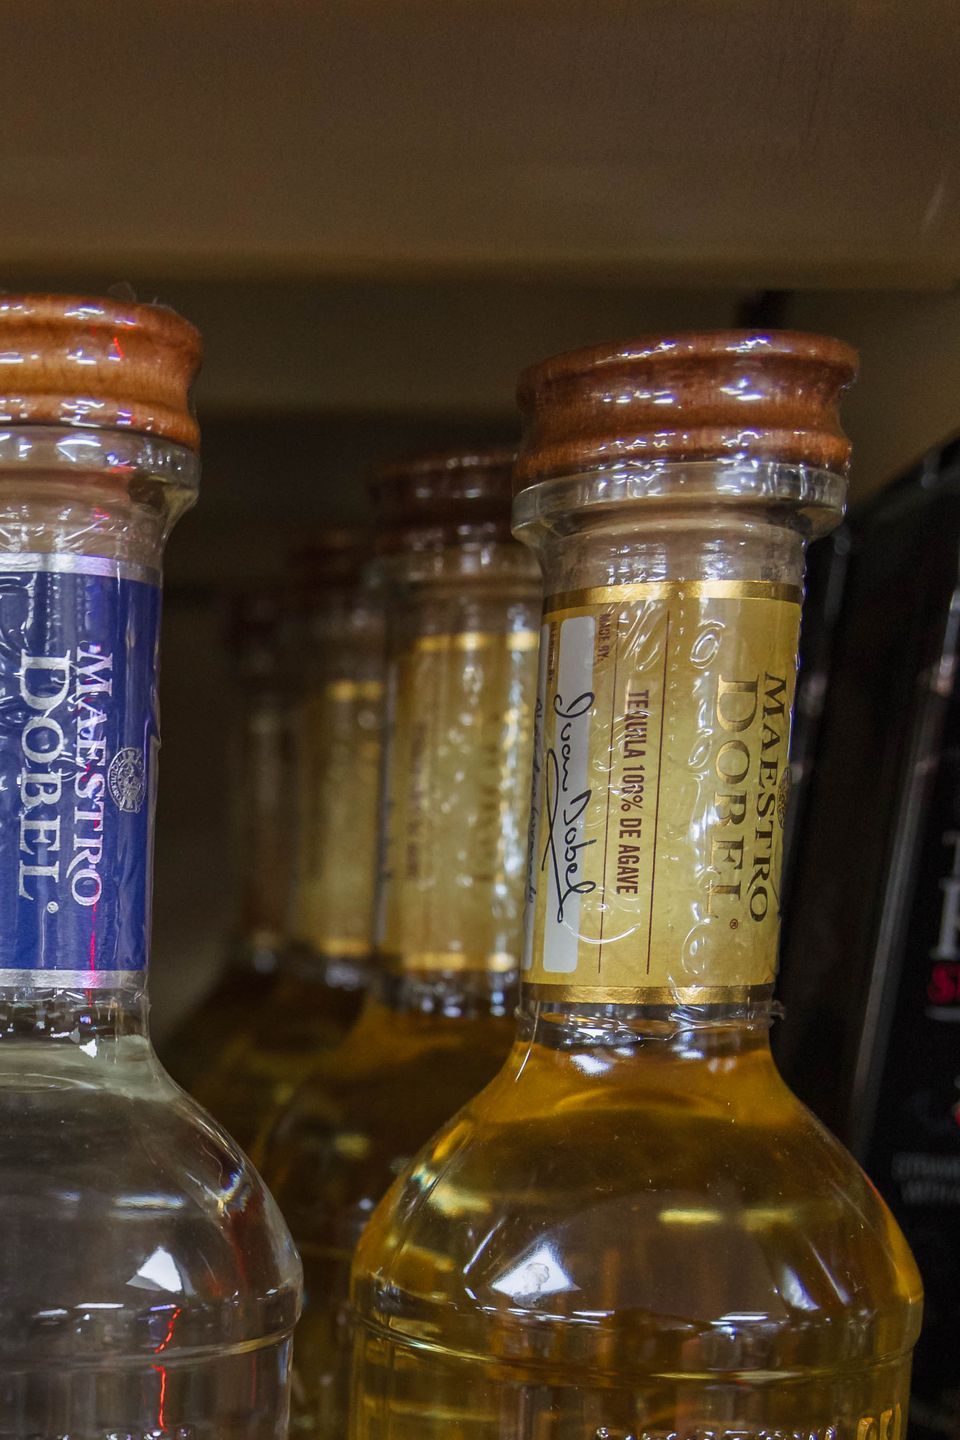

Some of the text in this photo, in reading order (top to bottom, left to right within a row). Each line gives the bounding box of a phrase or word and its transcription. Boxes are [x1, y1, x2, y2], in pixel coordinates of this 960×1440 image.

[17, 648, 73, 901] DOBEL
[66, 644, 114, 907] MAESTRO
[615, 689, 650, 895] TEQUILA 100% DE AGAVE
[707, 673, 760, 919] DOBEL
[746, 671, 787, 922] MAESTRO
